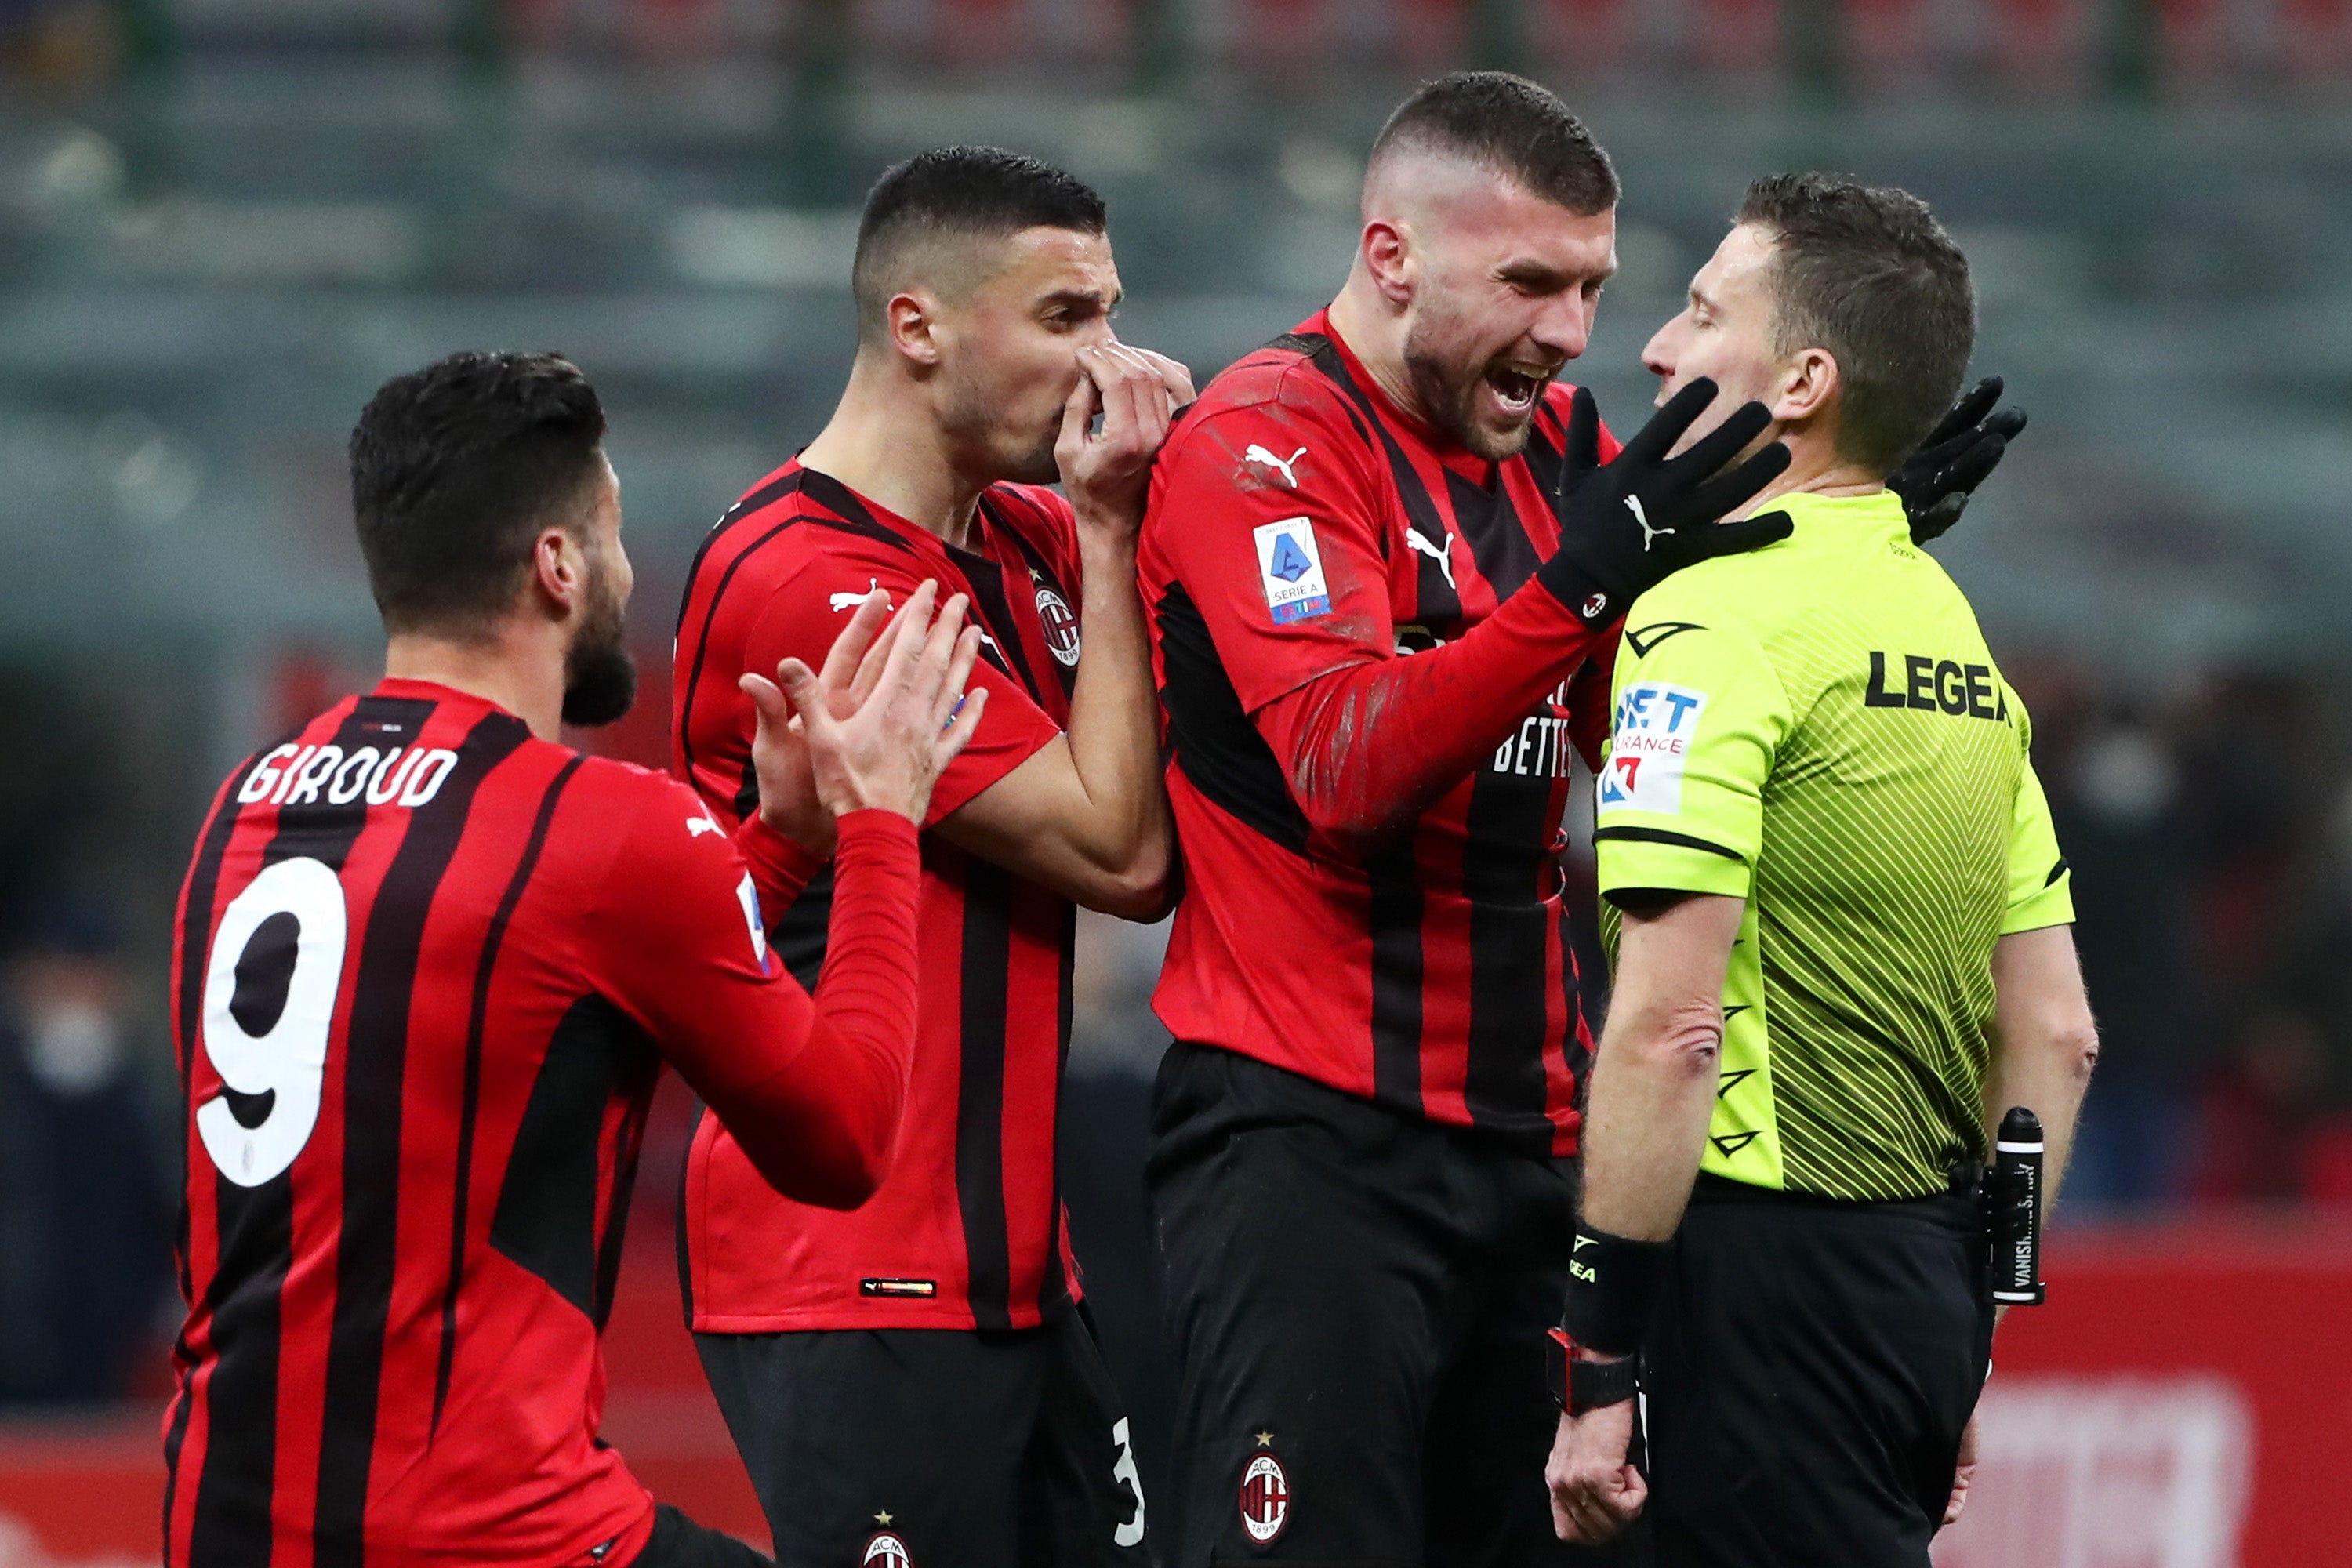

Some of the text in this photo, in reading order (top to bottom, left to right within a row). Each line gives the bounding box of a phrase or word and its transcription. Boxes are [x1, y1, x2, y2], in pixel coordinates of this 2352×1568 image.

[1037, 592, 1061, 605] ACM
[1274, 583, 1318, 602] SERIE A
[1059, 649, 1078, 661] 1899
[237, 743, 458, 807] GIROUD
[197, 856, 347, 1187] 9
[1251, 1459, 1279, 1475] ACM
[1251, 1523, 1276, 1534] 1899
[871, 1538, 902, 1555] ACM
